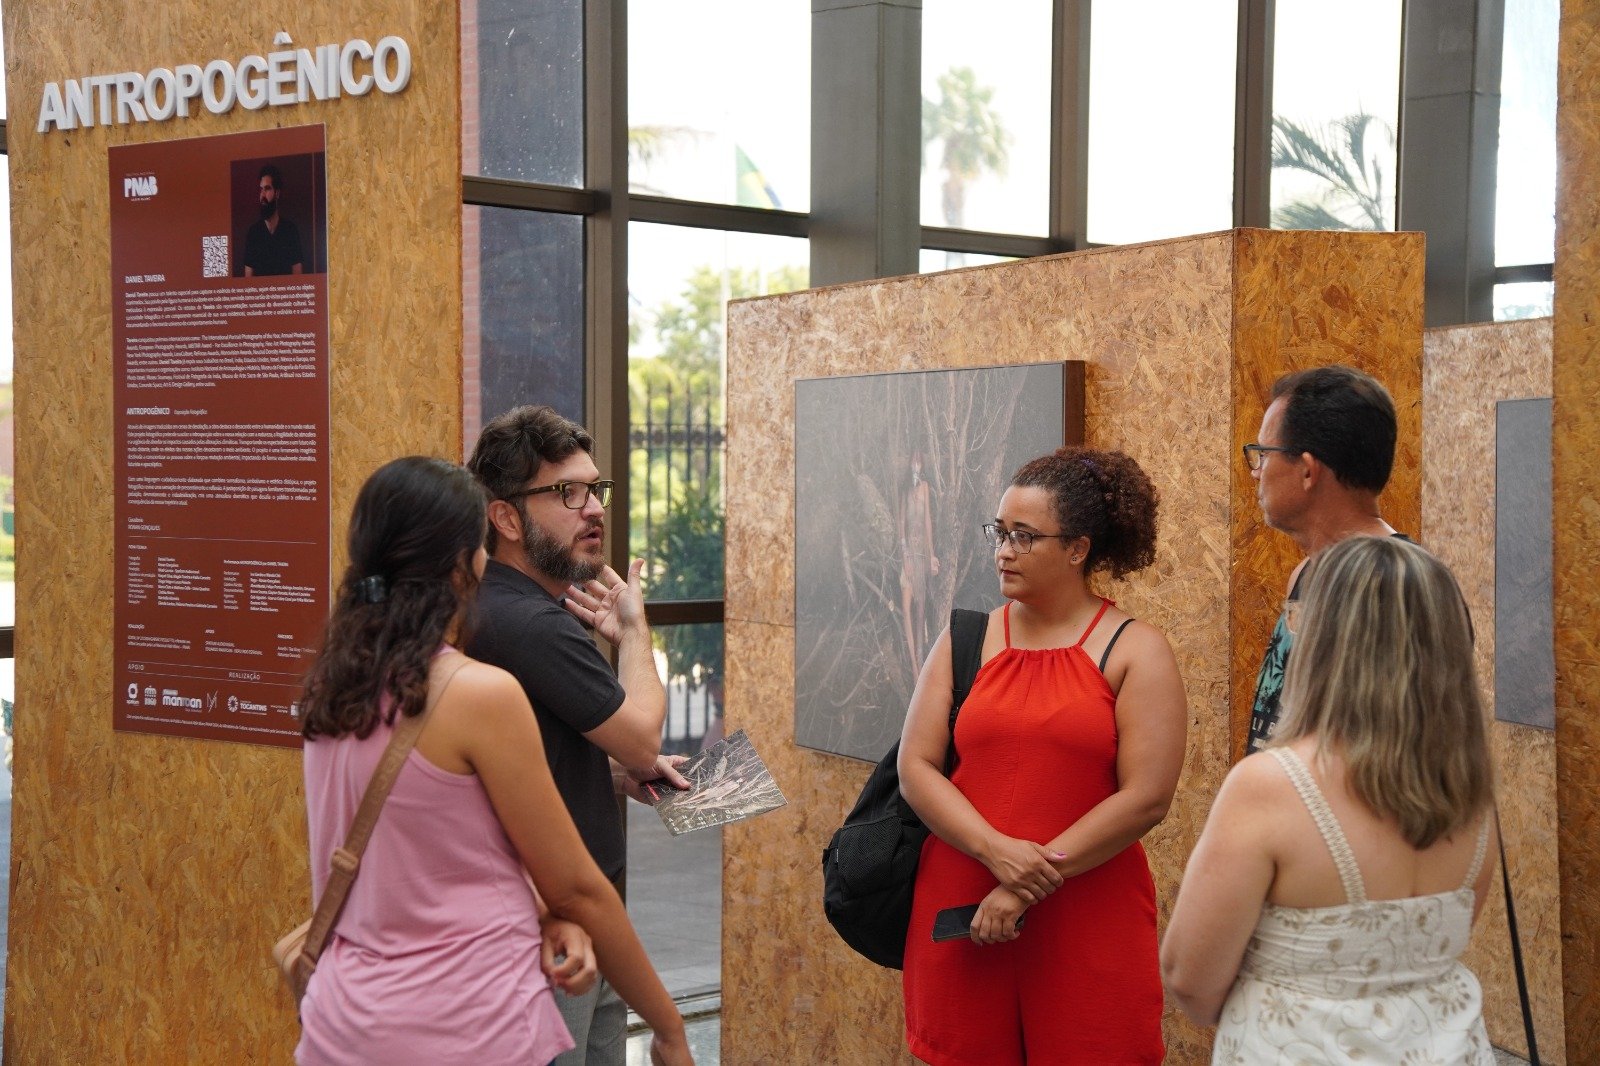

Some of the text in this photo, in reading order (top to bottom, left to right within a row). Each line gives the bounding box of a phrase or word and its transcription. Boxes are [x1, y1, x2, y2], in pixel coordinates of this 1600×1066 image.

[37, 31, 411, 133] ANTROPOGÊNICO
[125, 274, 165, 283] DANIEL TAVEIRA
[127, 406, 170, 415] ANTROPOGÊNICO
[127, 663, 144, 671] APOIO
[228, 671, 261, 681] REALIZAÇÃO
[240, 703, 267, 712] TOCANTINS
